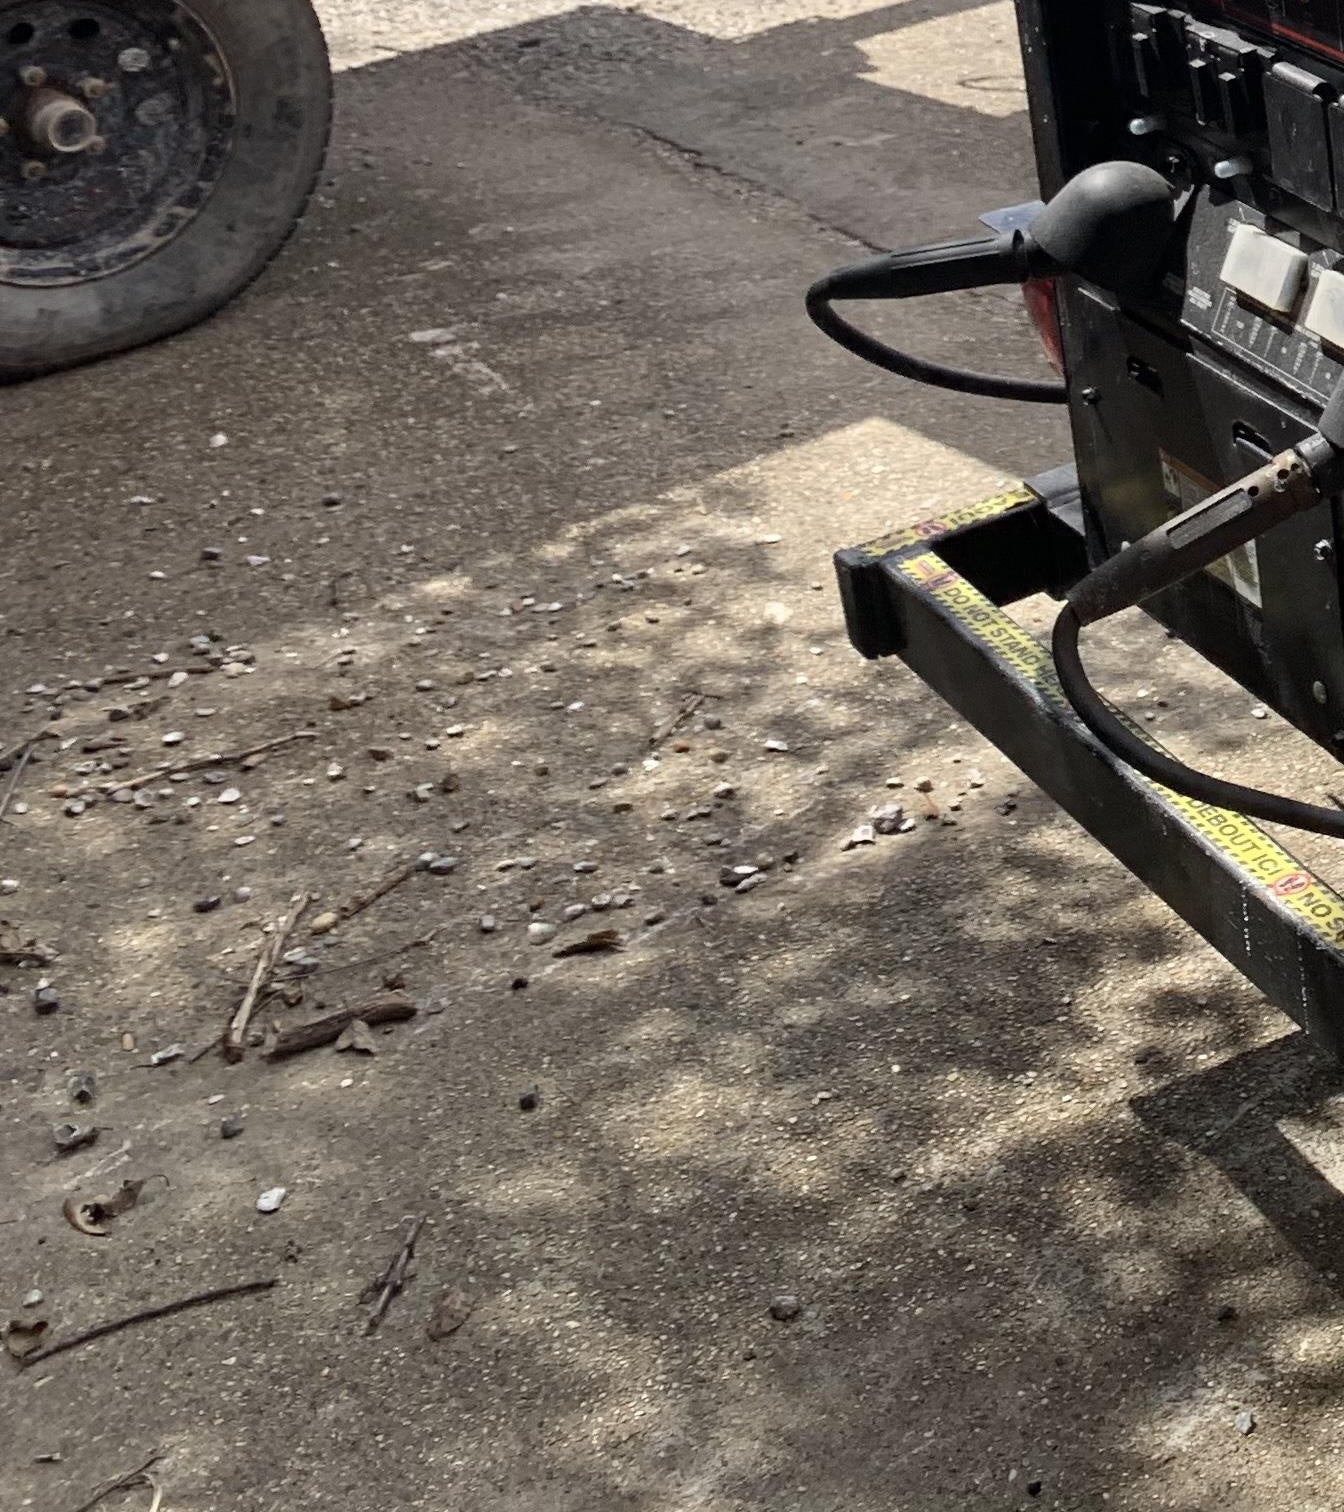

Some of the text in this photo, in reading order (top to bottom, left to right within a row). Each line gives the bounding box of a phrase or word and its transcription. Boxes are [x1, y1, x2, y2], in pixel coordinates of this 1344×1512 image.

[943, 586, 969, 605] DO
[966, 604, 1000, 630] NOT
[990, 627, 1041, 667] STAND
[1186, 797, 1285, 876] DEBOUT ICI
[1297, 893, 1332, 916] NO
